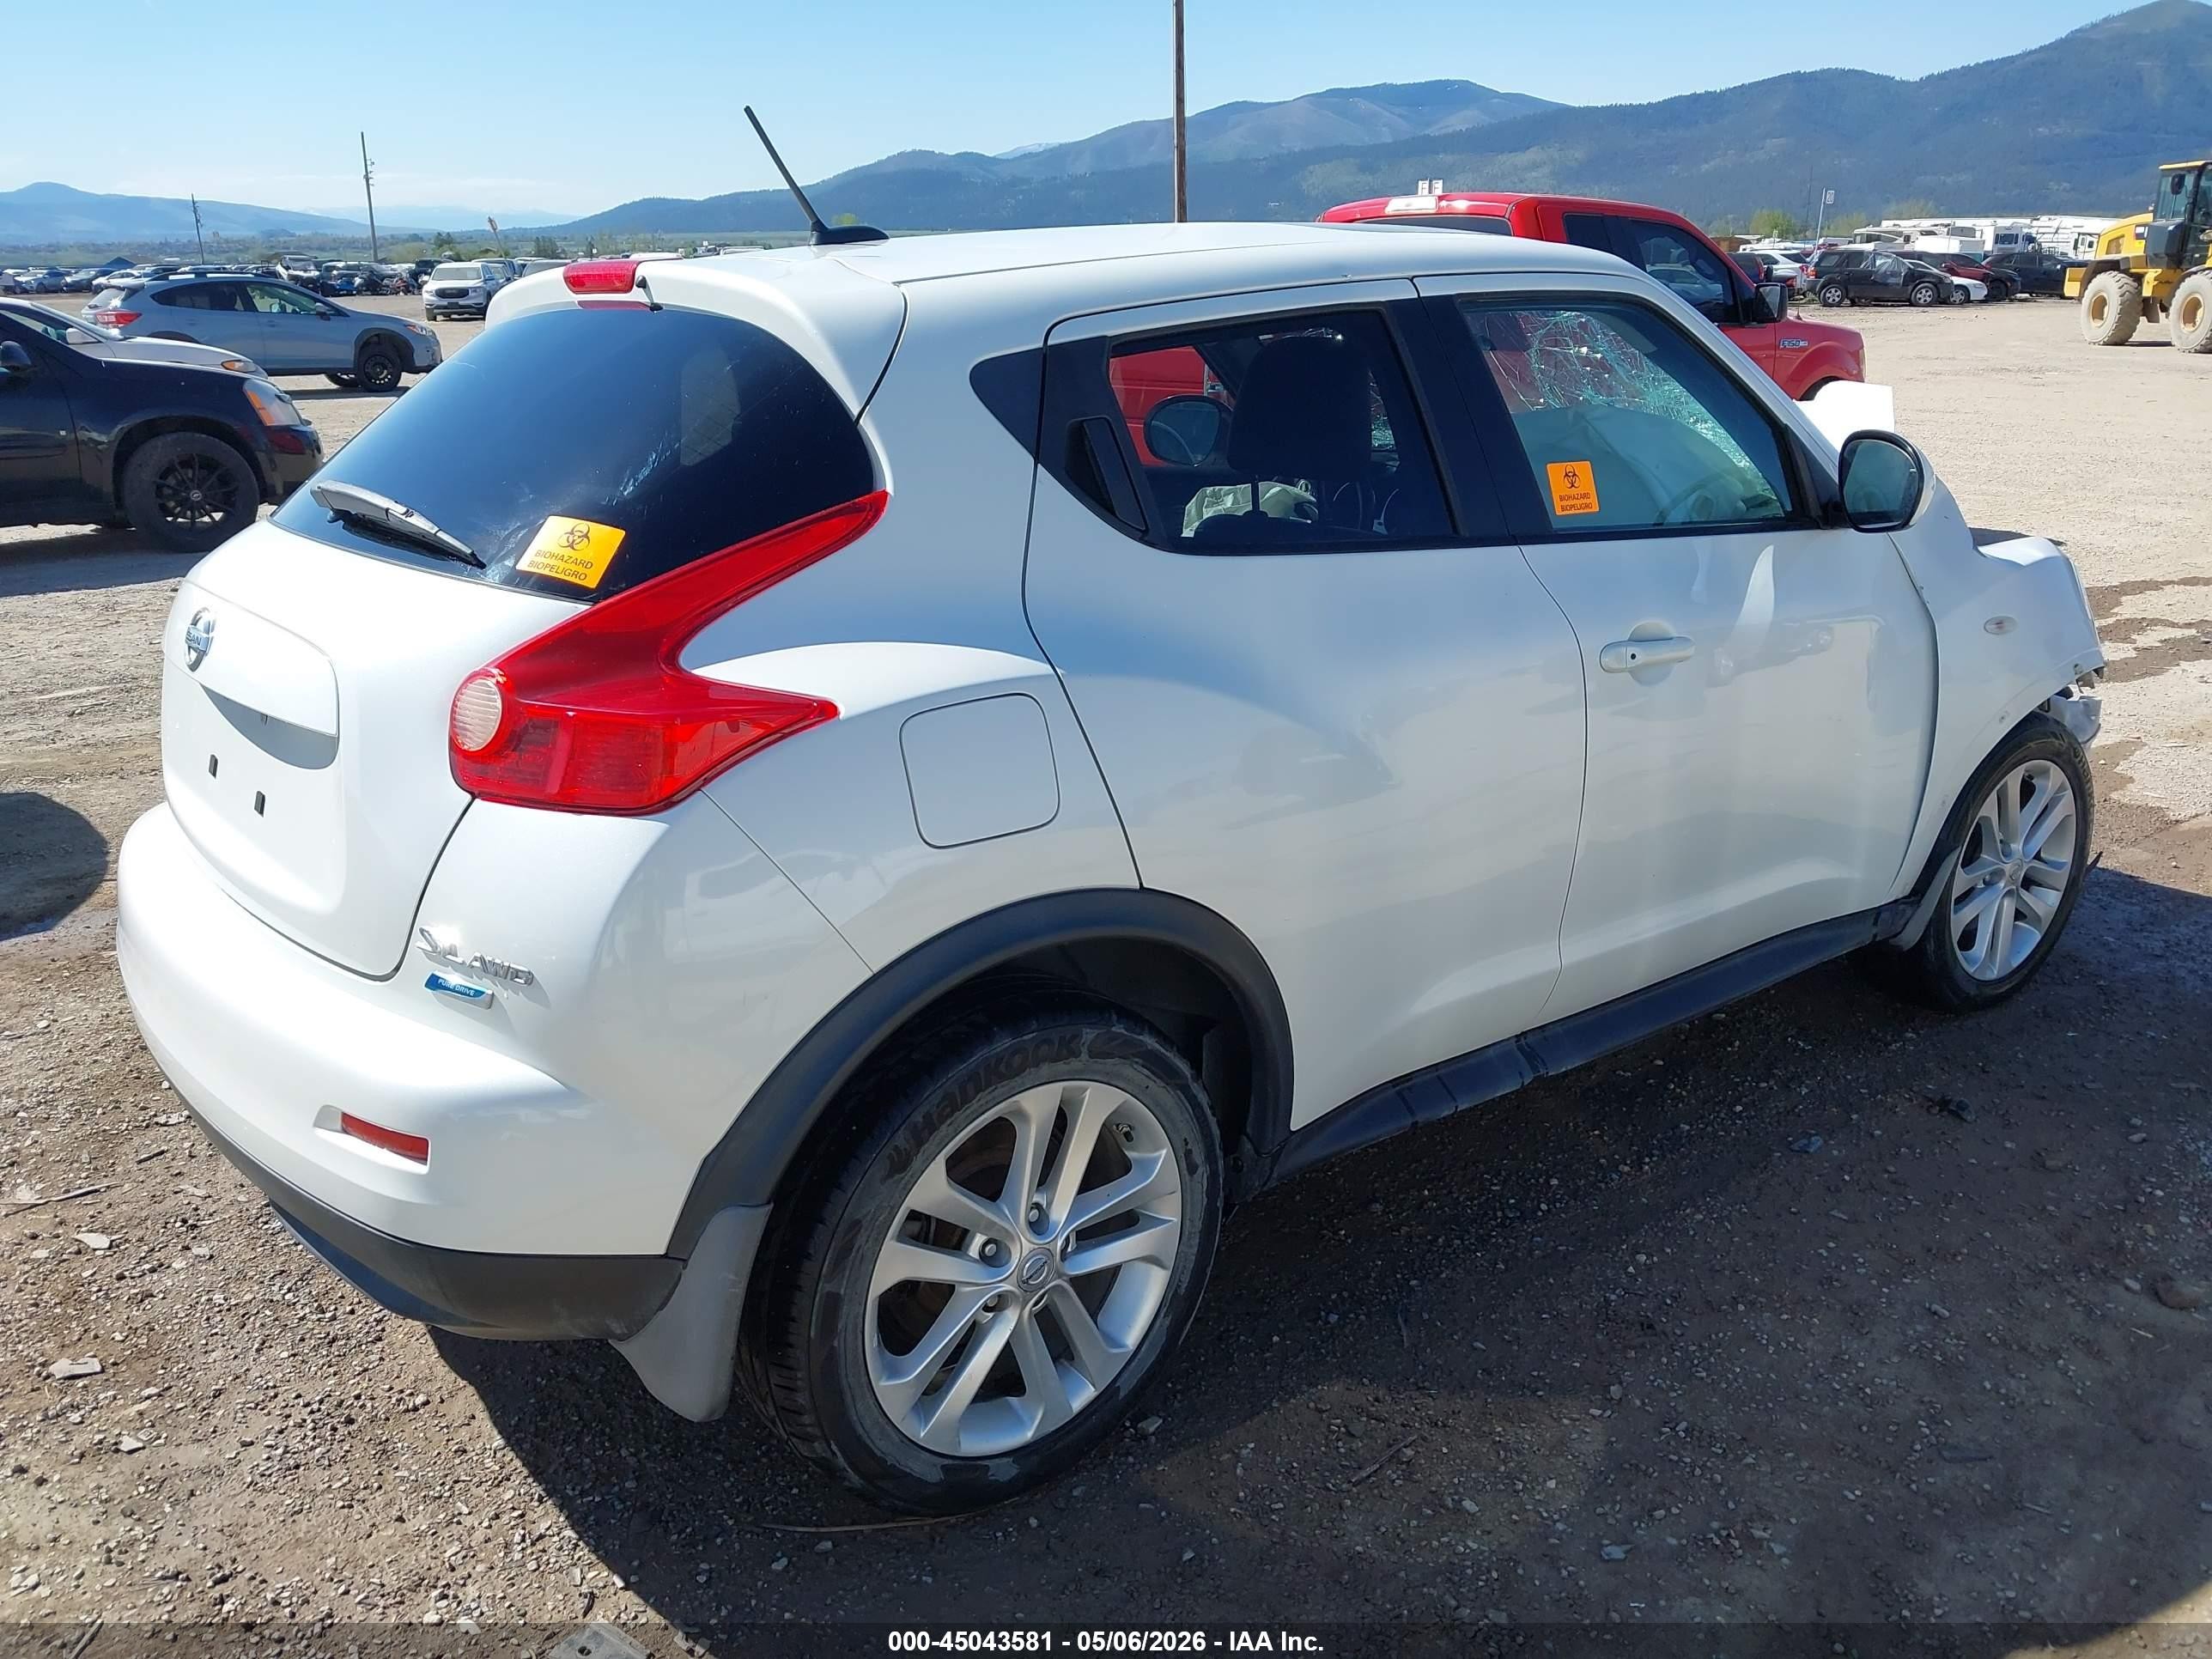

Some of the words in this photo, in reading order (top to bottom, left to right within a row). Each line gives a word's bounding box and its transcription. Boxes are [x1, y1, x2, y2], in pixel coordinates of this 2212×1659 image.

[1559, 491, 1591, 501] BIOHAZARD
[1560, 502, 1593, 512] BIOPELIGRO
[534, 550, 593, 570] BIOHAZARD
[527, 560, 587, 581] BIOPELIGRO
[466, 951, 534, 987] AWD
[437, 977, 454, 991] PURE
[454, 983, 476, 997] DRIVE
